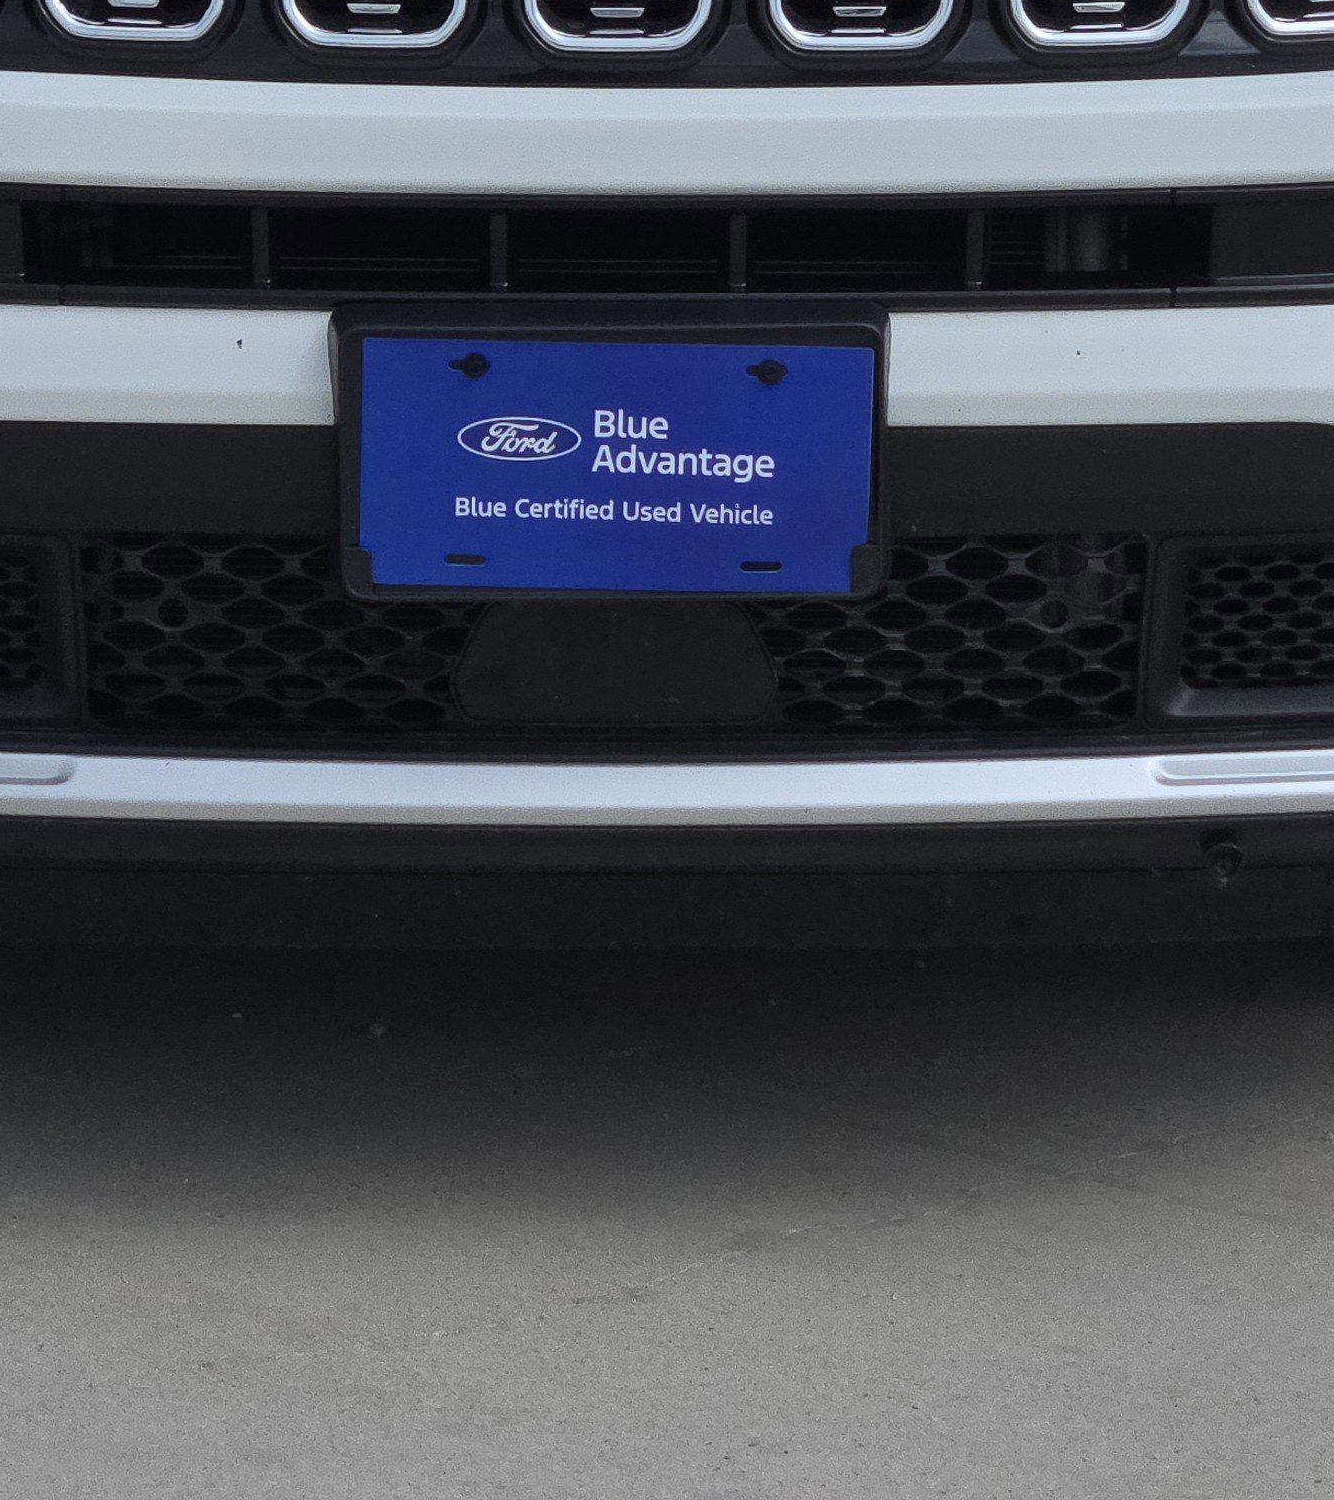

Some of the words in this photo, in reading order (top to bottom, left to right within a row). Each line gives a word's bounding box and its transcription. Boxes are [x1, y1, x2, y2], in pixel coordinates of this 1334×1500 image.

[481, 421, 556, 455] Ford
[594, 409, 669, 439] Blue
[591, 444, 775, 483] Advantage
[454, 496, 507, 518] Blue
[514, 497, 614, 521] Certified
[622, 501, 681, 524] Used
[689, 503, 774, 526] Vehicle
